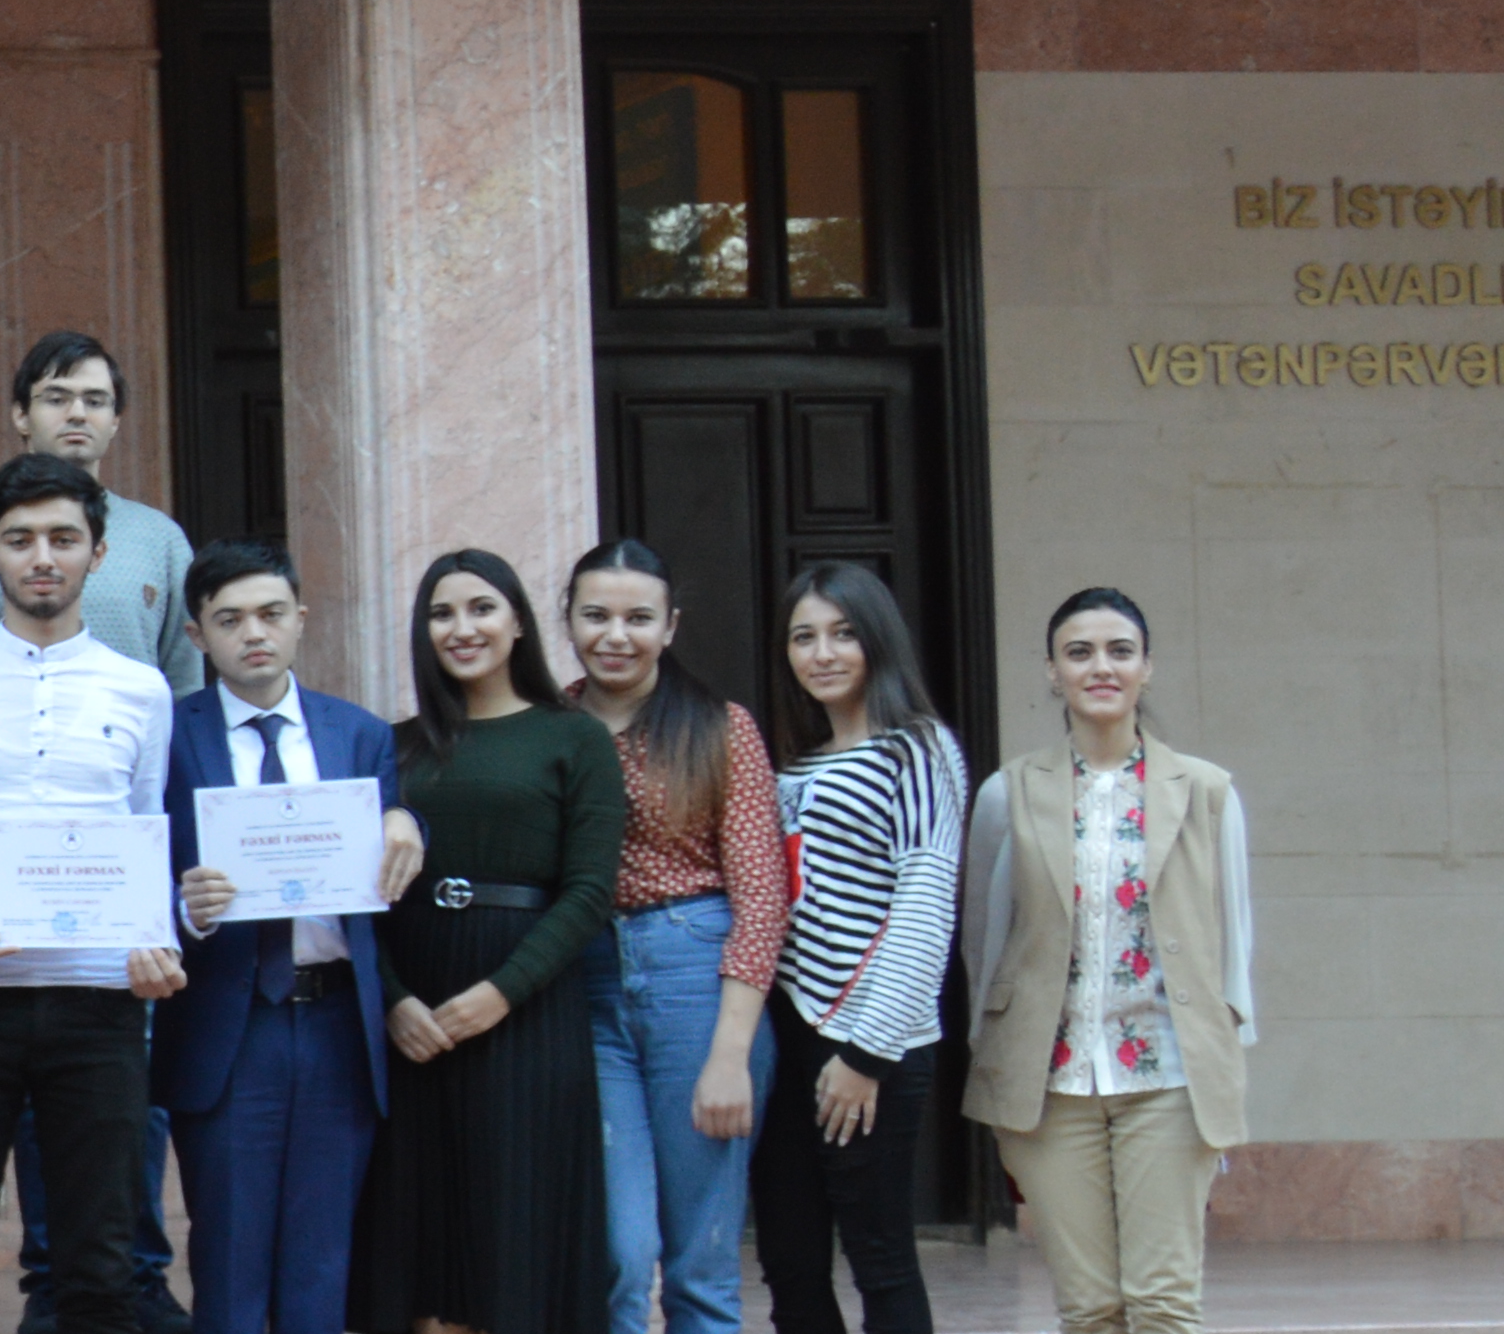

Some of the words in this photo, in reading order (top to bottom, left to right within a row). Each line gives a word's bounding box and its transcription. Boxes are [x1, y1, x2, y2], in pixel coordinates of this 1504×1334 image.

[1234, 176, 1320, 229] BİZ
[1333, 175, 1504, 229] İSTƏYİ
[1294, 262, 1504, 307] SAVADL
[240, 833, 281, 847] FƏXRİ
[285, 831, 343, 845] FƏRMAN
[17, 864, 60, 876] FƏXRİ
[65, 865, 126, 876] FƏRMAN
